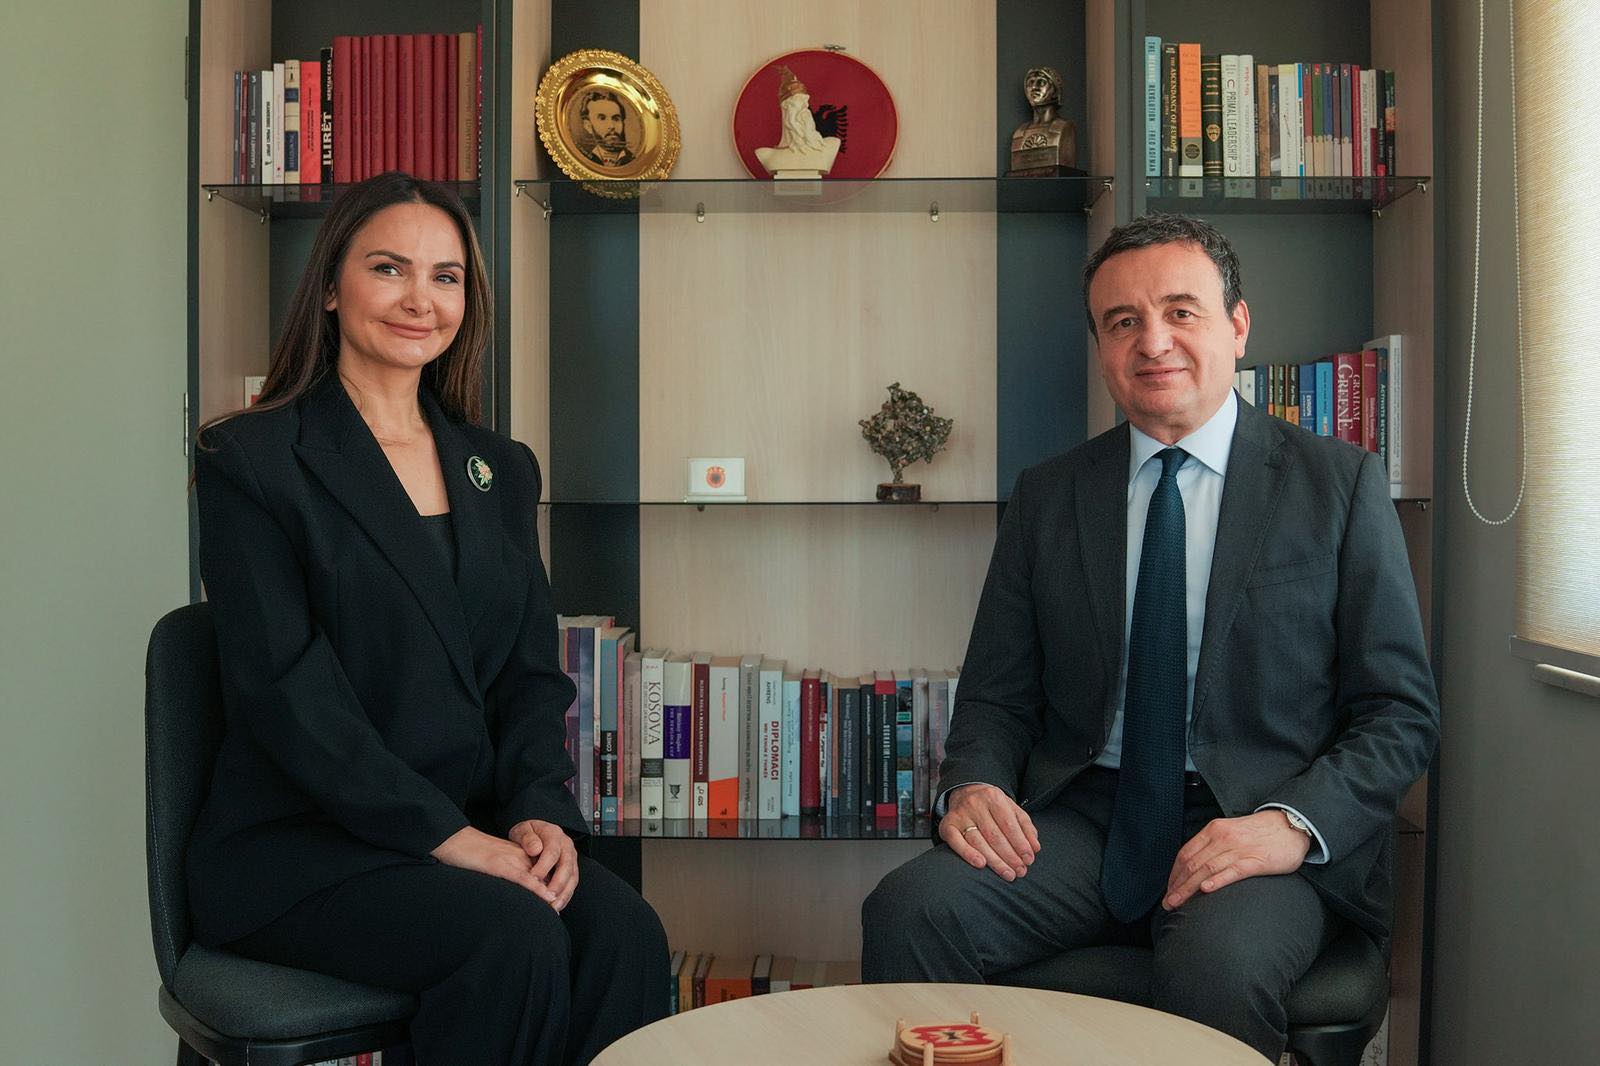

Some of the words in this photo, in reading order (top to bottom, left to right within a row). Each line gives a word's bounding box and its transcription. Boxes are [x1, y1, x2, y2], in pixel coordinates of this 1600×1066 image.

[1170, 114, 1177, 124] OF
[1227, 91, 1237, 117] PRIMAL
[321, 112, 332, 166] ILIRËT
[1227, 118, 1238, 161] LEADERSHIP
[1337, 363, 1354, 431] GREENE
[1352, 374, 1360, 421] GRAHAM
[648, 682, 661, 745] KOSOVA
[770, 721, 779, 781] DIPLOMACI
